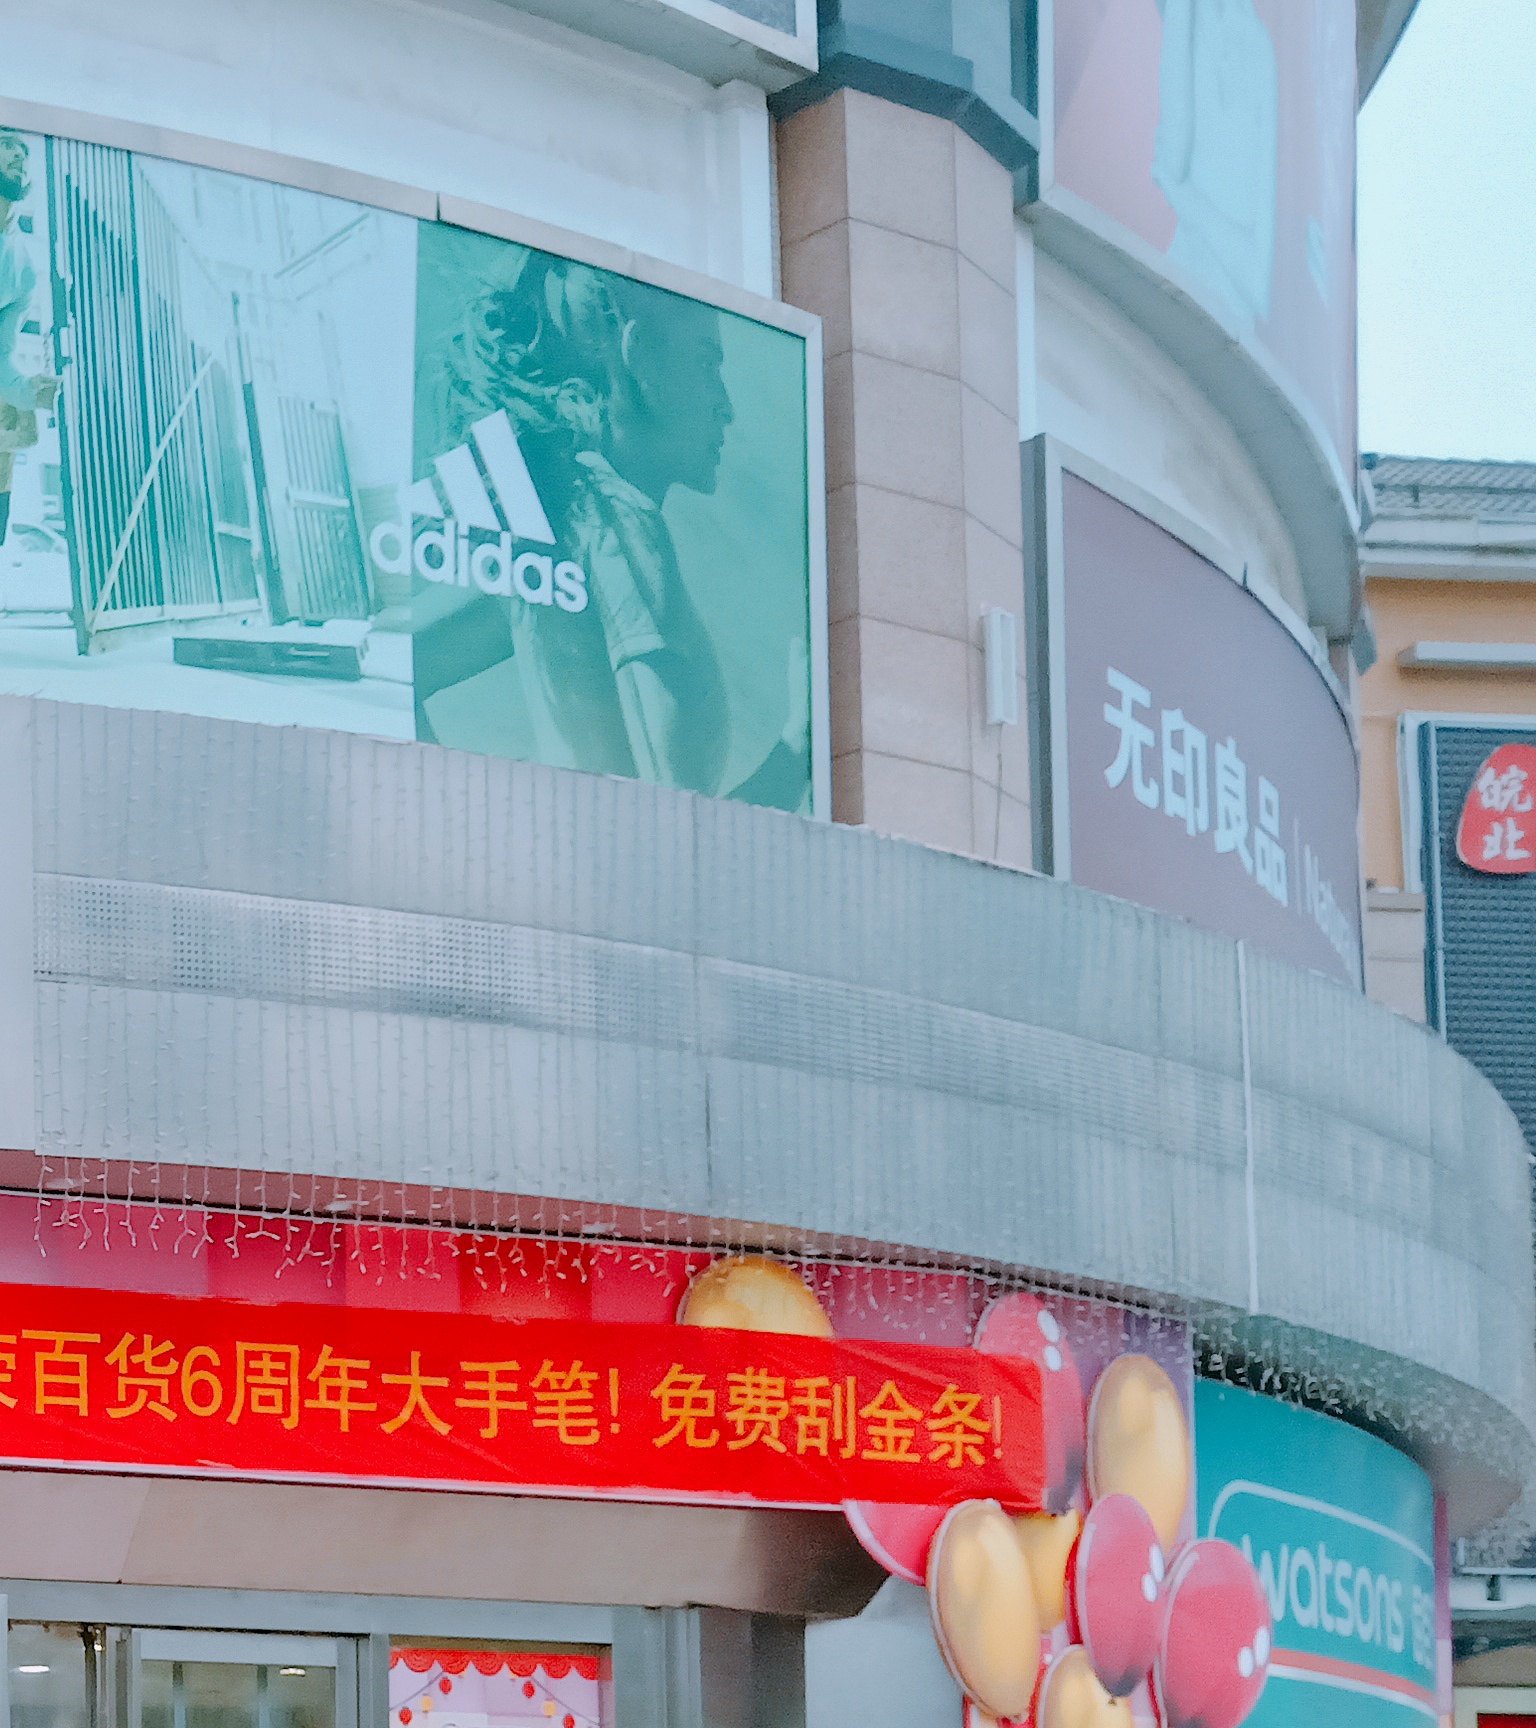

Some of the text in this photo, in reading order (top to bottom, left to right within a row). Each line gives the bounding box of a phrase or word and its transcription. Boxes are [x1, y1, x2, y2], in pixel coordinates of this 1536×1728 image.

[369, 510, 589, 613] adidas
[1103, 665, 1289, 908] 无印良品
